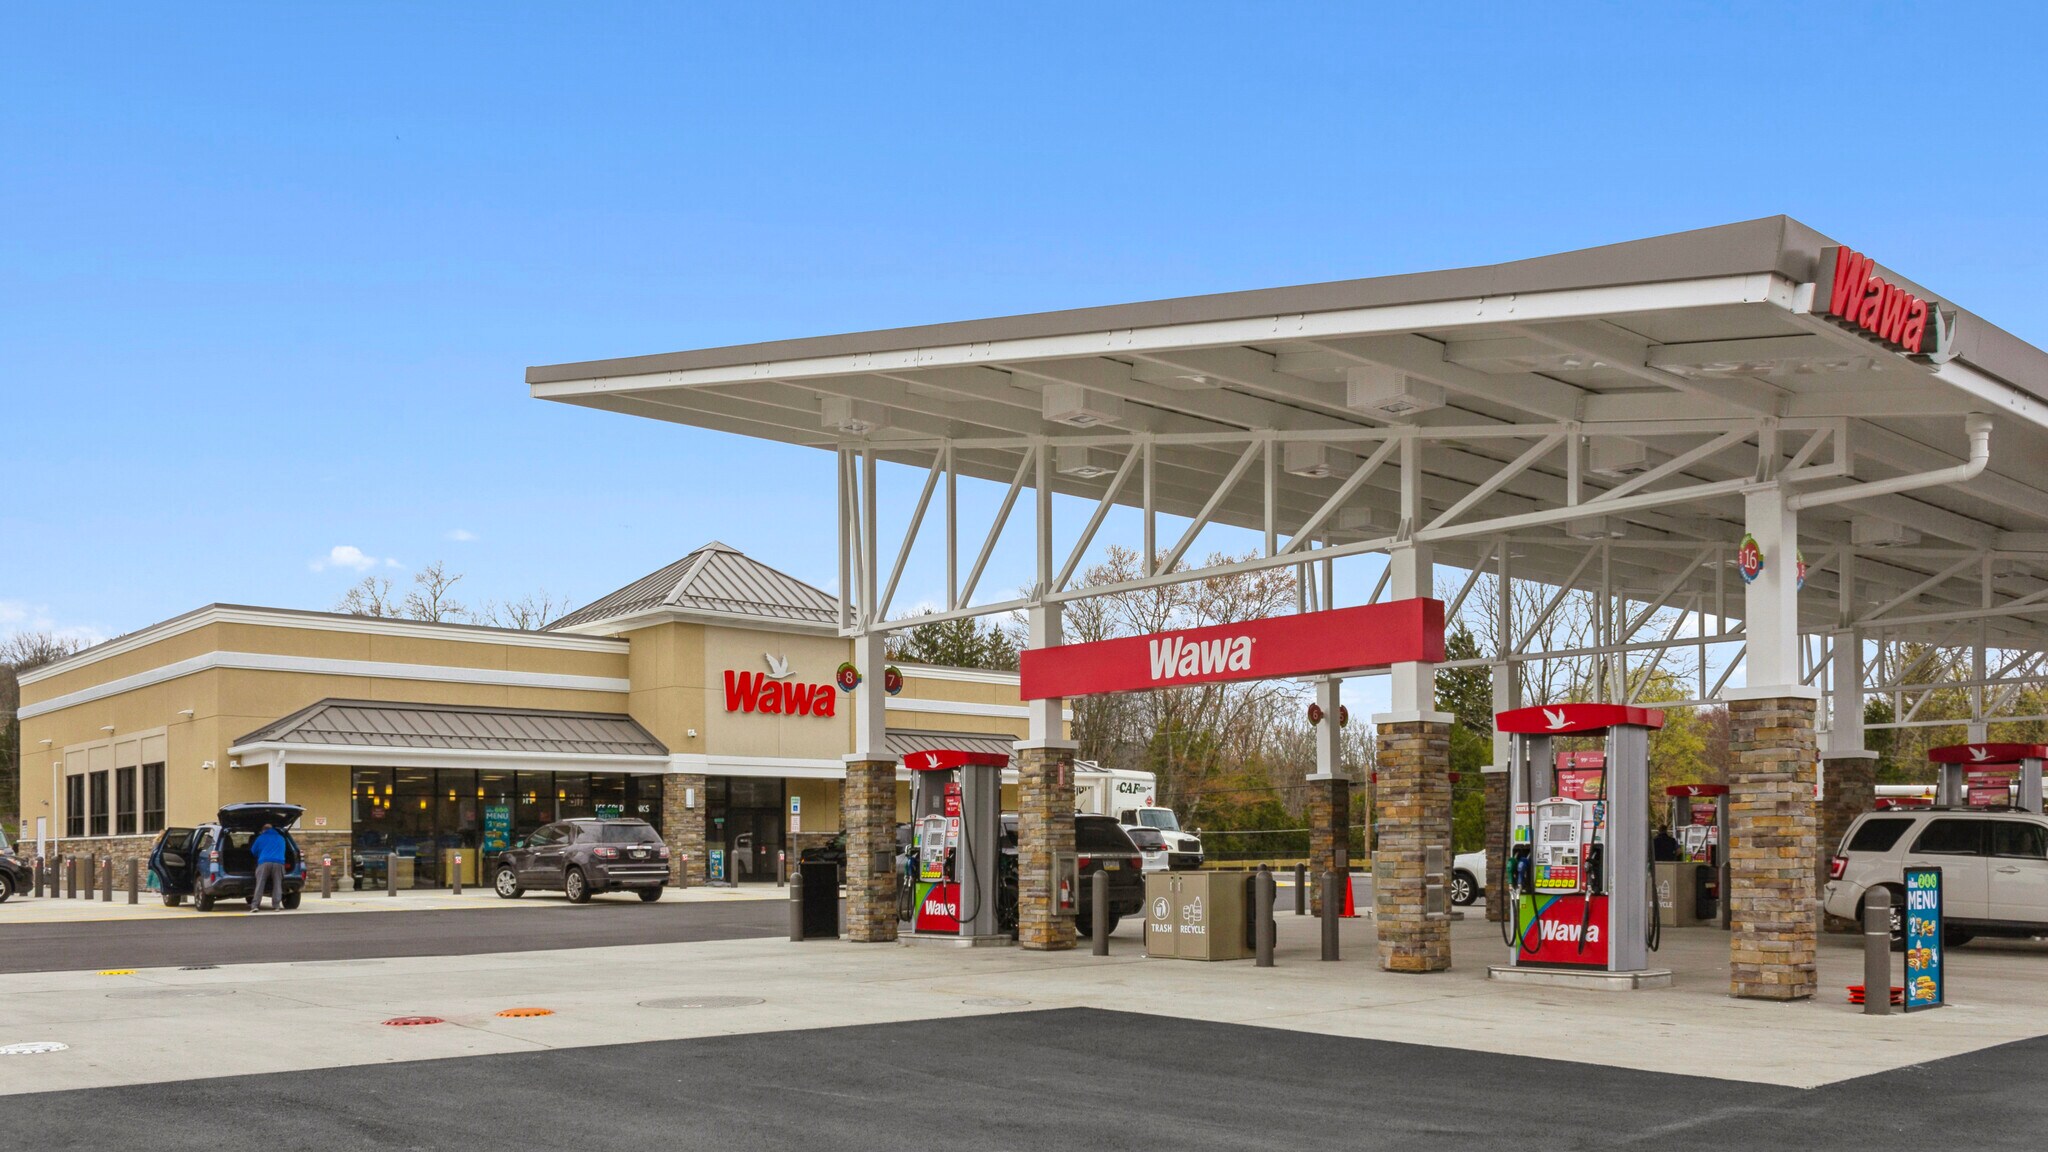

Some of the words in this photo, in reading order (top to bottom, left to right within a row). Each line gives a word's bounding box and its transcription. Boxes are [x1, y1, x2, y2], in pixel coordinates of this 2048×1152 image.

[1829, 245, 1928, 354] Wawa
[1744, 549, 1757, 569] 16
[1149, 635, 1252, 680] Wawa
[845, 671, 853, 684] 8
[887, 674, 896, 687] 7
[723, 669, 836, 717] Wawa
[486, 812, 509, 820] MENU
[1649, 901, 1673, 909] RYCLE
[1907, 890, 1938, 910] MENU
[925, 900, 956, 916] Wawa
[1151, 923, 1172, 933] TRASH
[1180, 925, 1206, 934] RECYCLE
